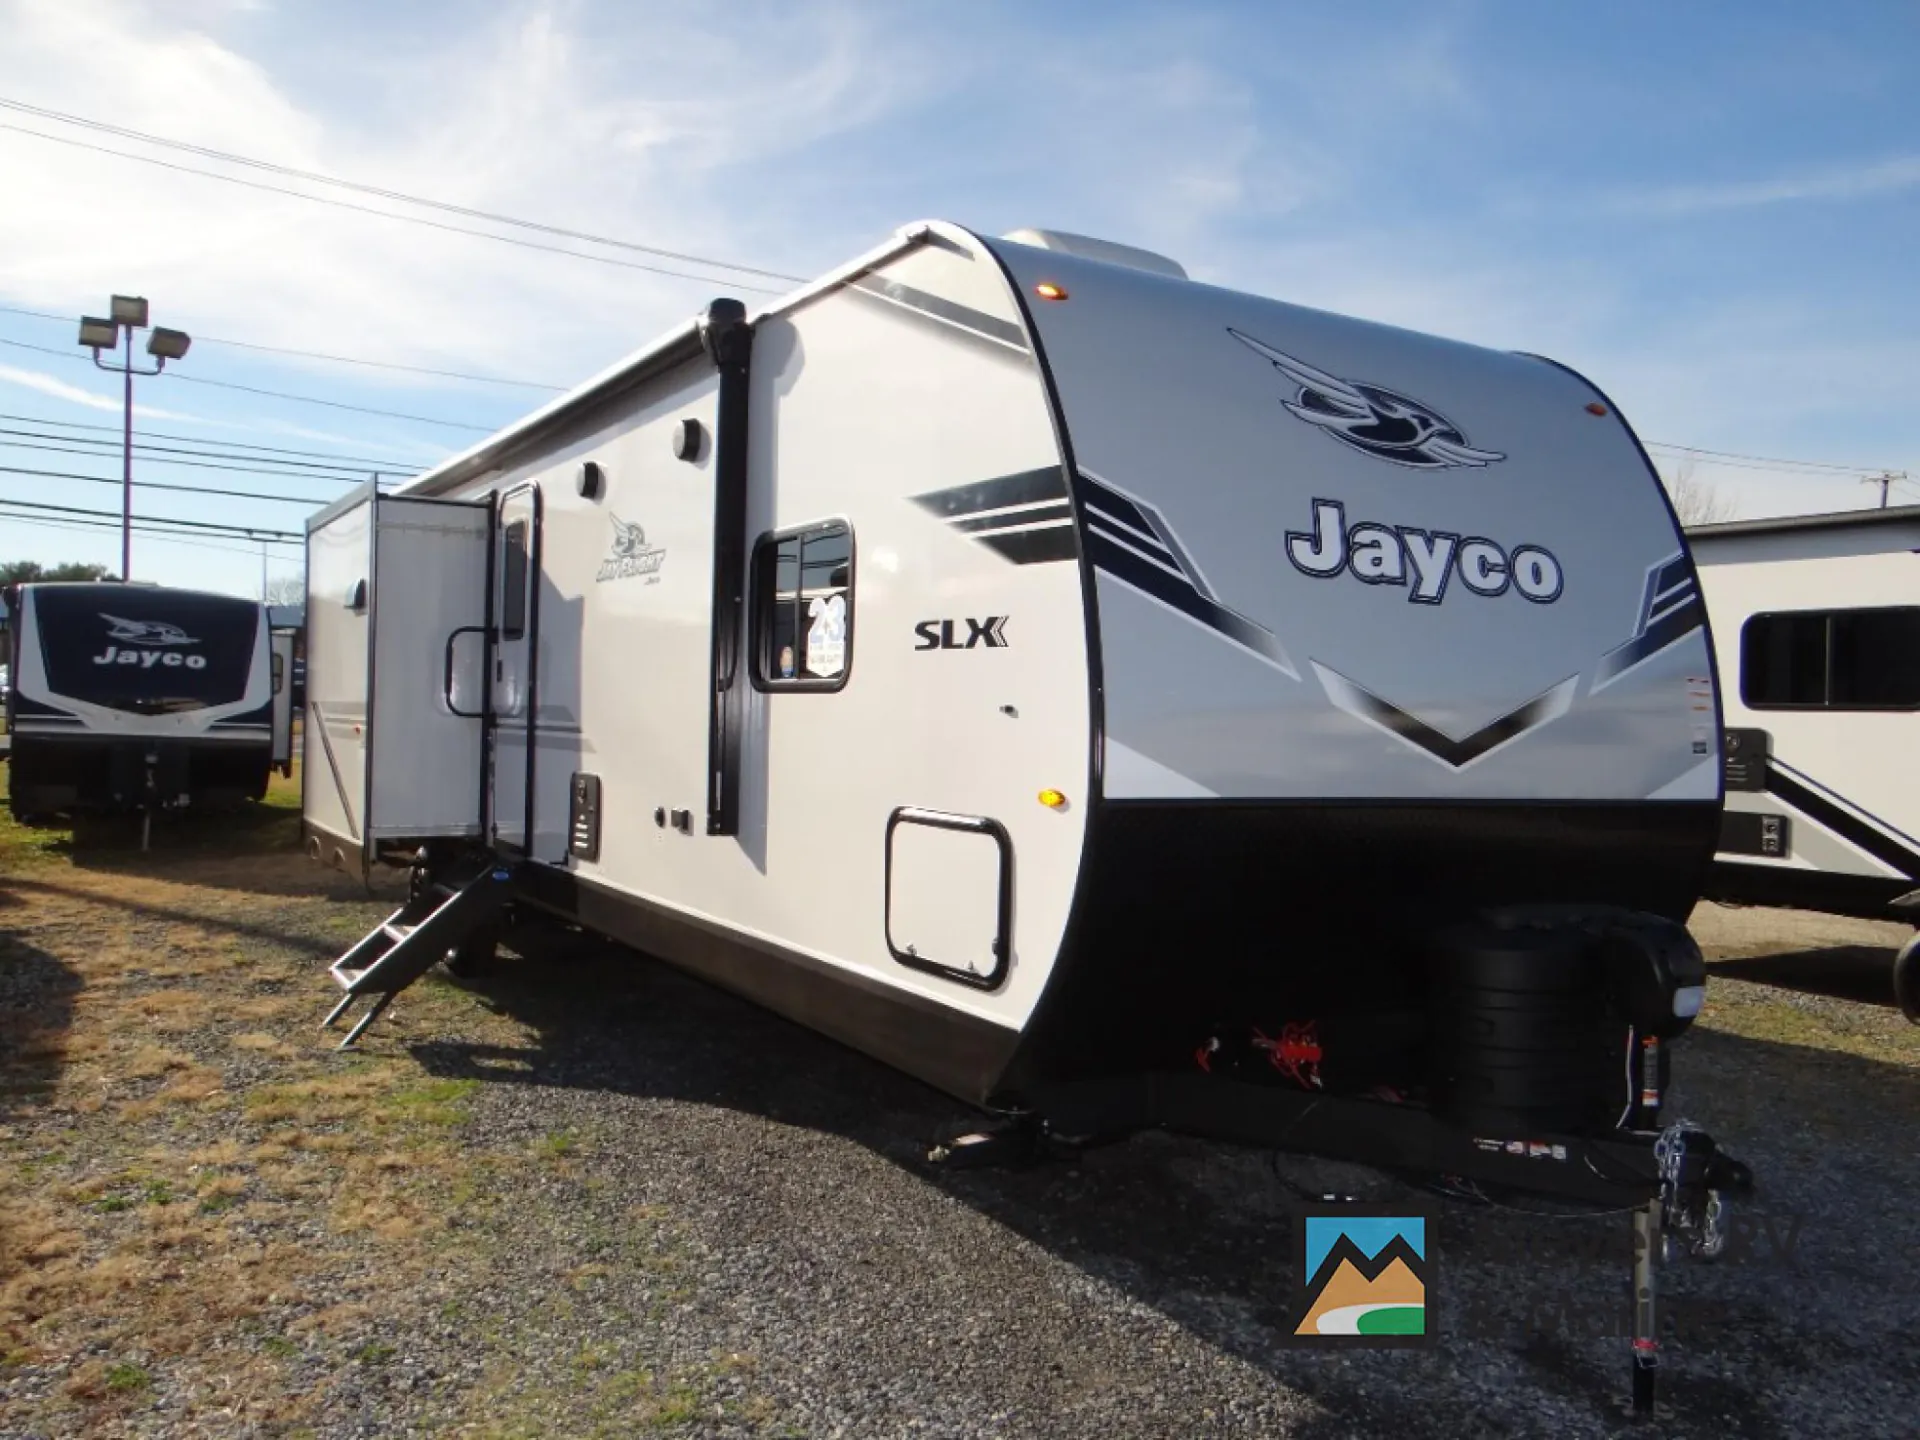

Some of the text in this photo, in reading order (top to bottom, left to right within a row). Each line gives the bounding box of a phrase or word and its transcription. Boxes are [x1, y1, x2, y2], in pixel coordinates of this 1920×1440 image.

[1284, 498, 1565, 605] Jayco
[914, 616, 1008, 651] SLX
[93, 646, 206, 669] Jayco
